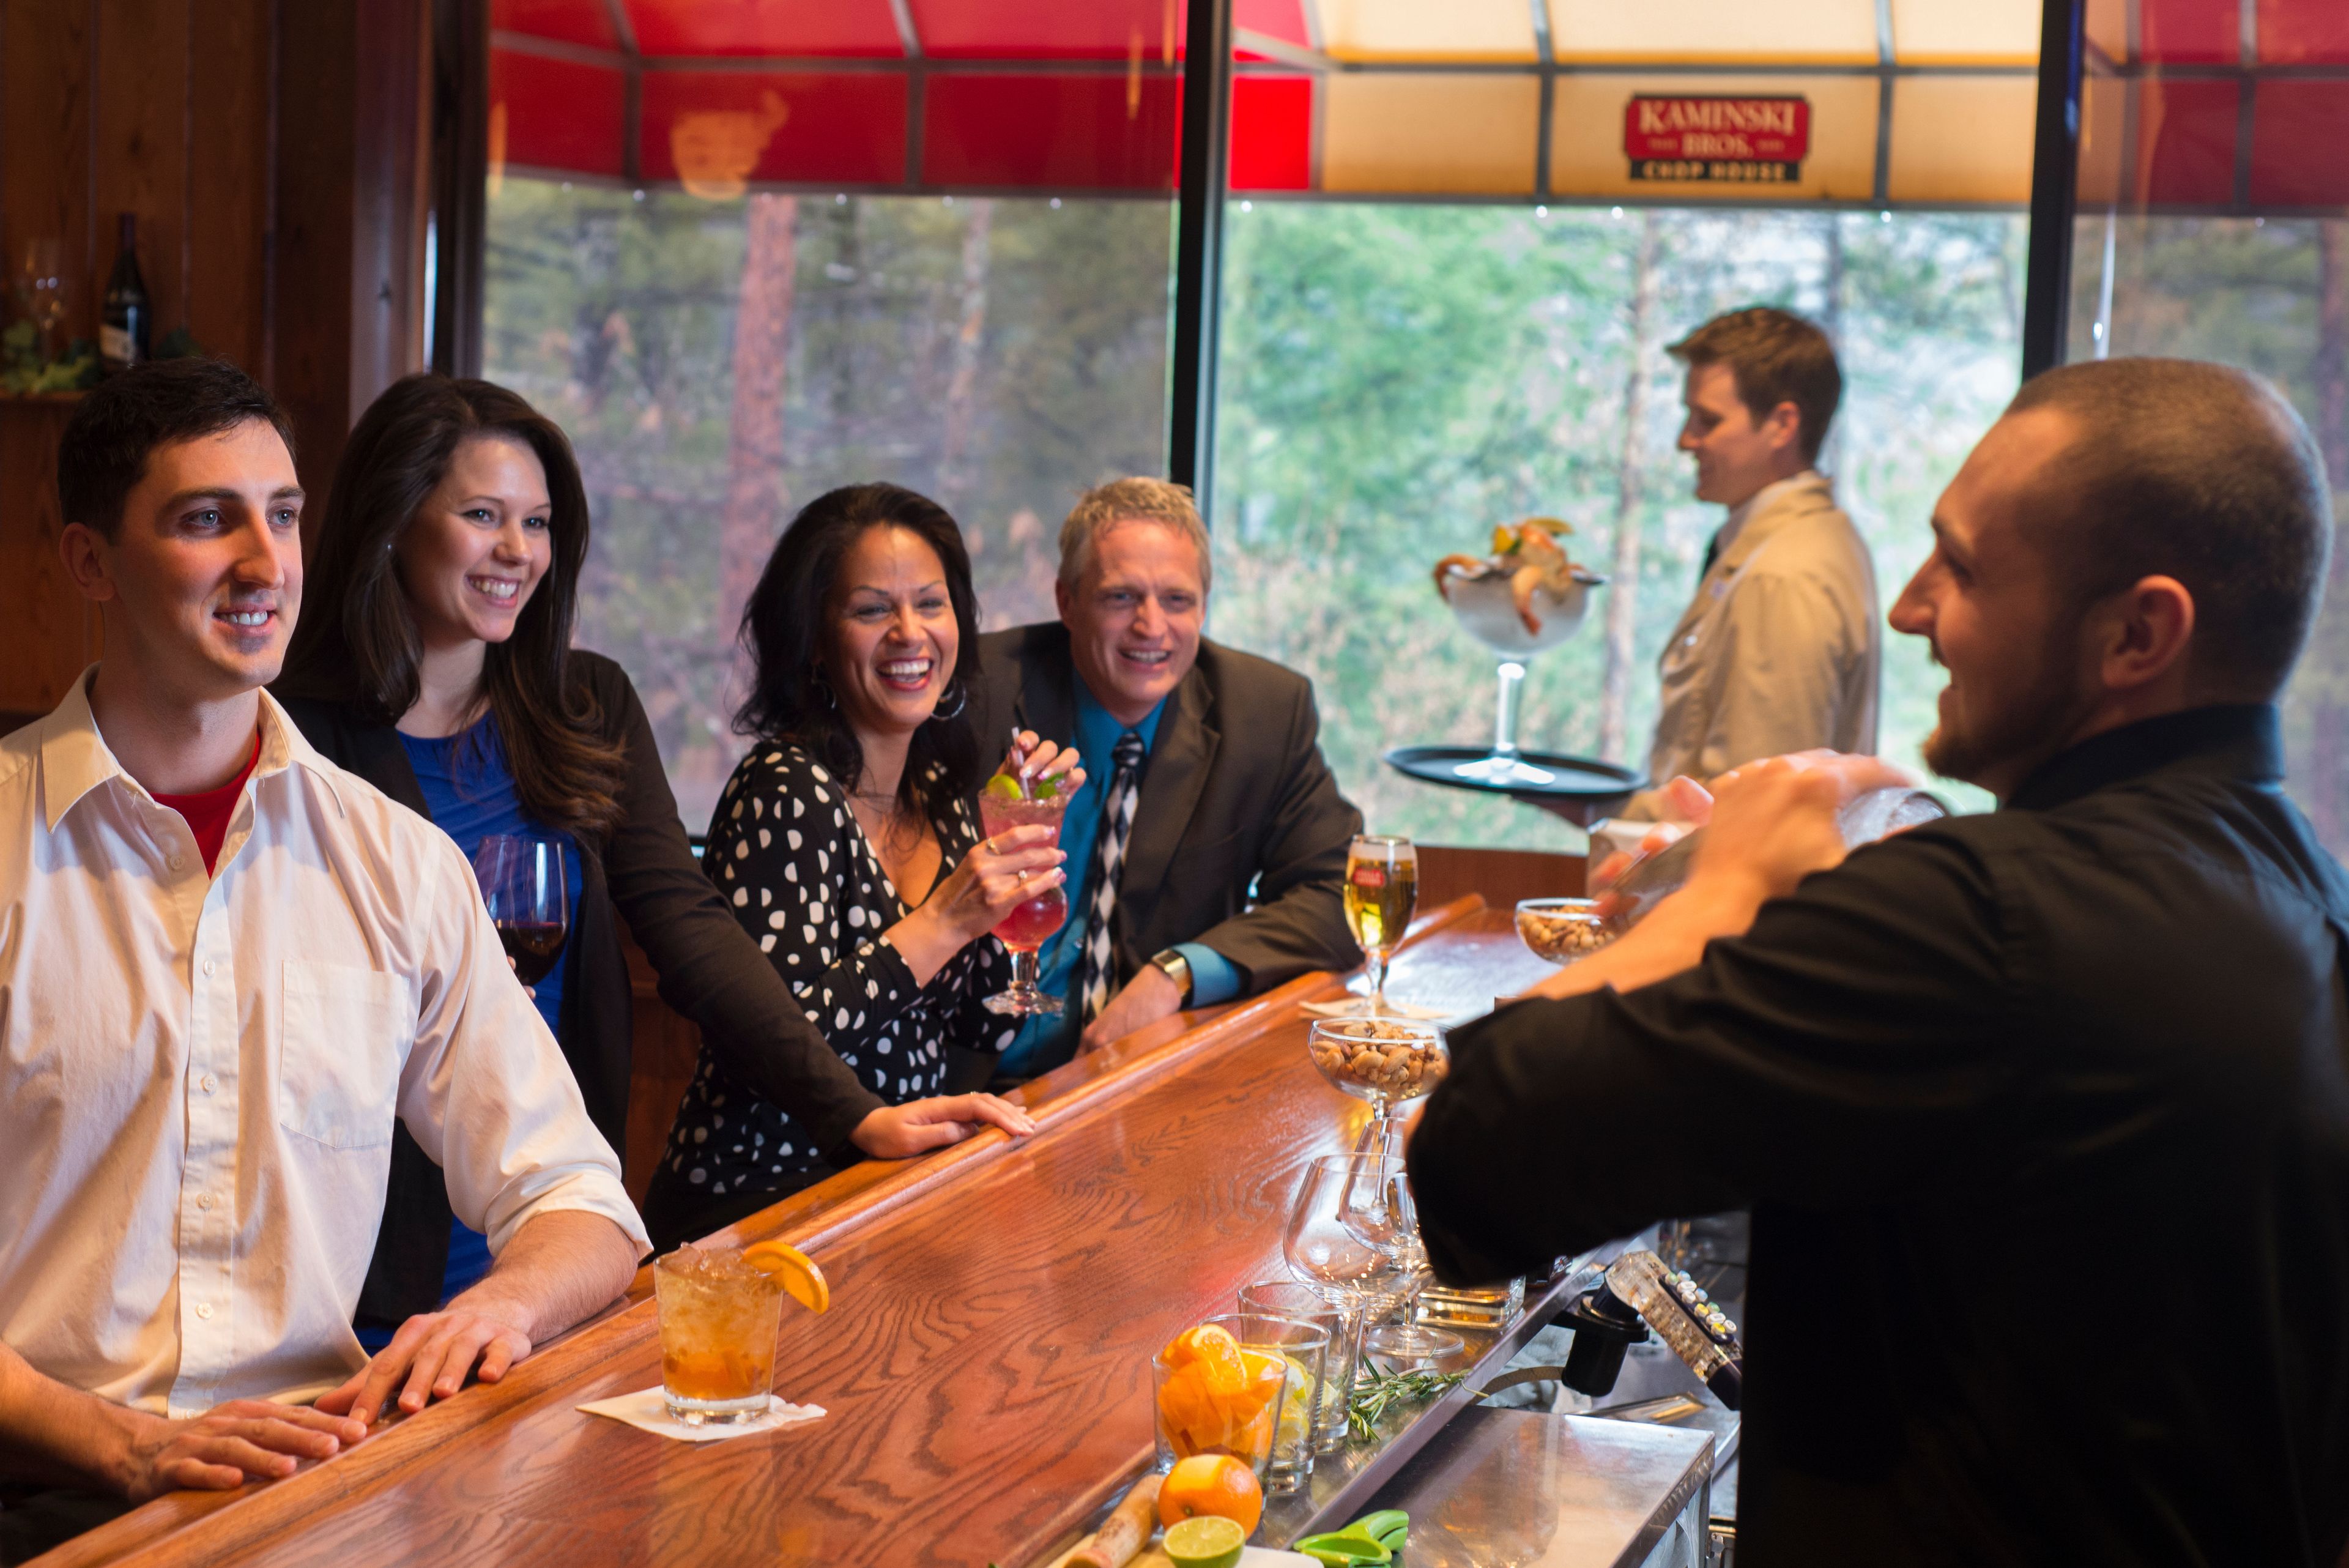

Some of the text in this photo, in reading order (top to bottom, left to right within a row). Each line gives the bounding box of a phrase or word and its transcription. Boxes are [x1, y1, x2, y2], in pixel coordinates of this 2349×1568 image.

[1639, 100, 1795, 136] KAMINSKI
[1642, 160, 1786, 181] CHOP HOUSE
